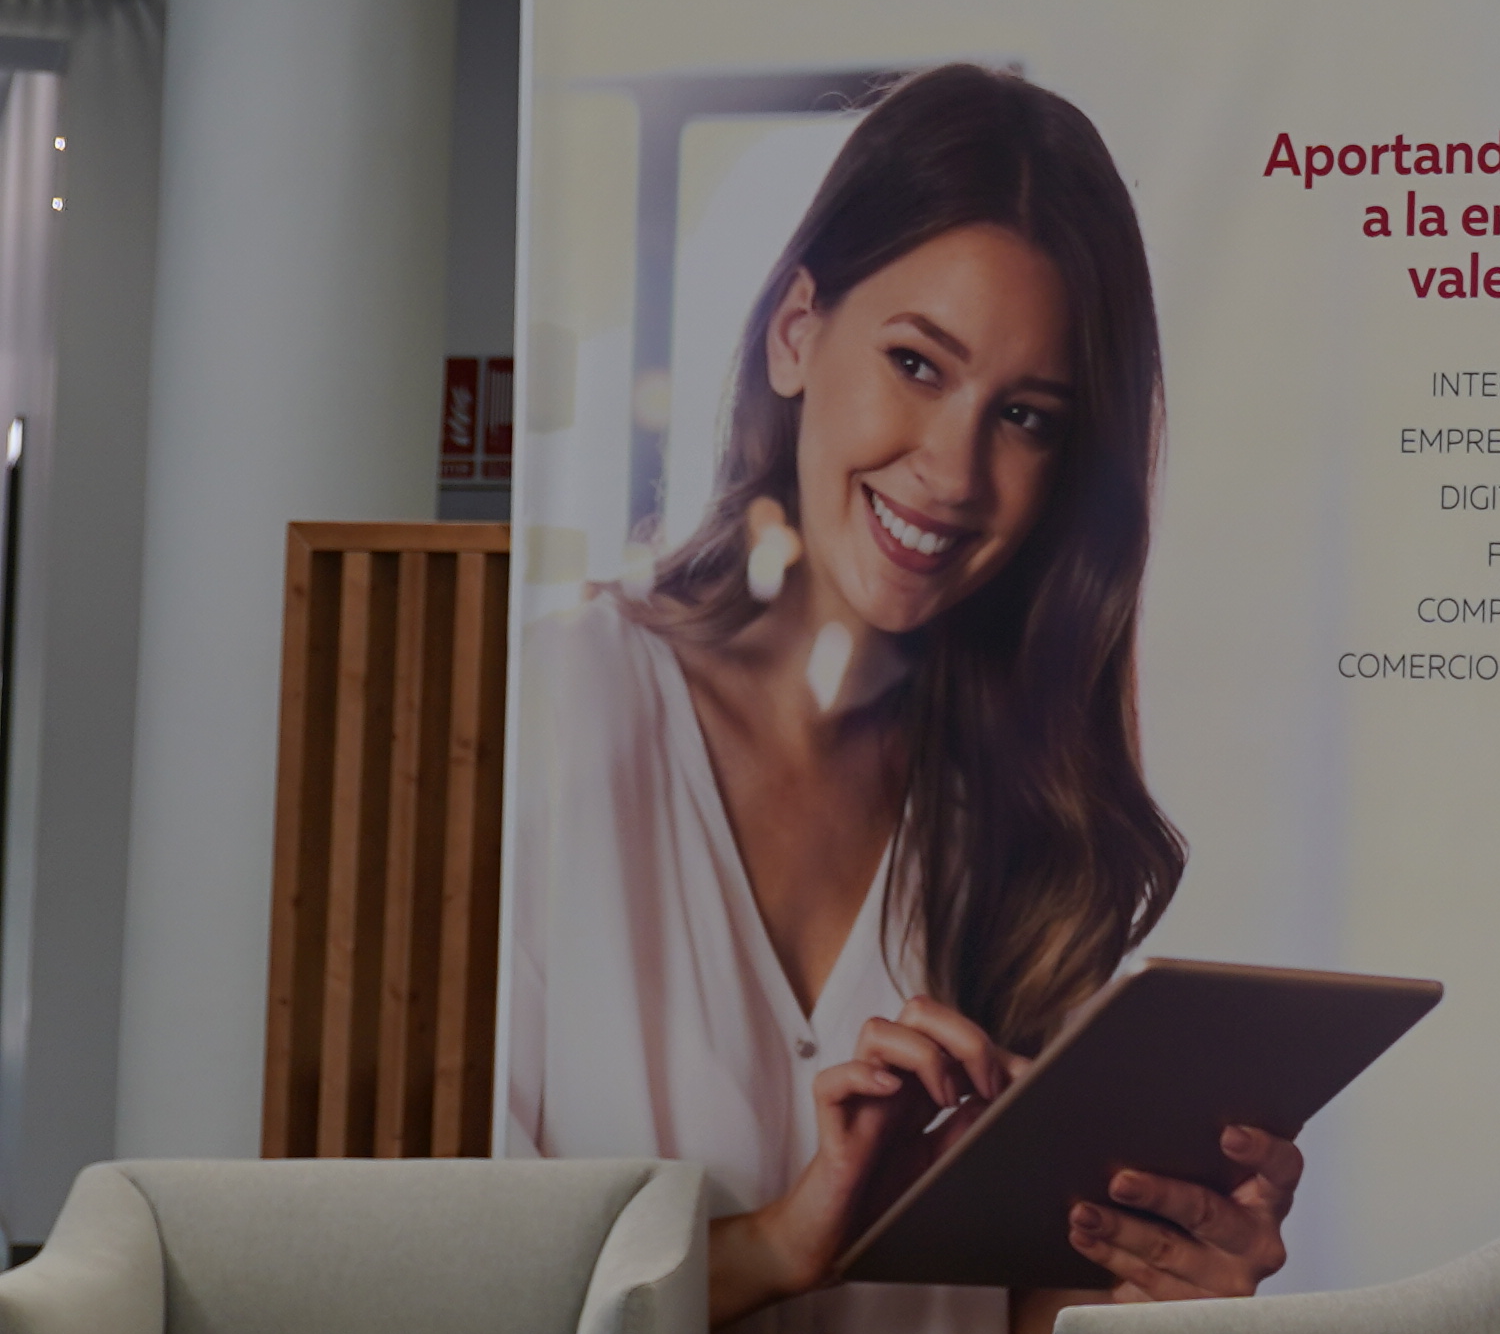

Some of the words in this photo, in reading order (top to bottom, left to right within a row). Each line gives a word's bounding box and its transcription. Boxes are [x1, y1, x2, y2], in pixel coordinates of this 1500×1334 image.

[1363, 206, 1392, 238] a
[1406, 191, 1448, 237] la
[1337, 653, 1498, 681] COMERCIO
